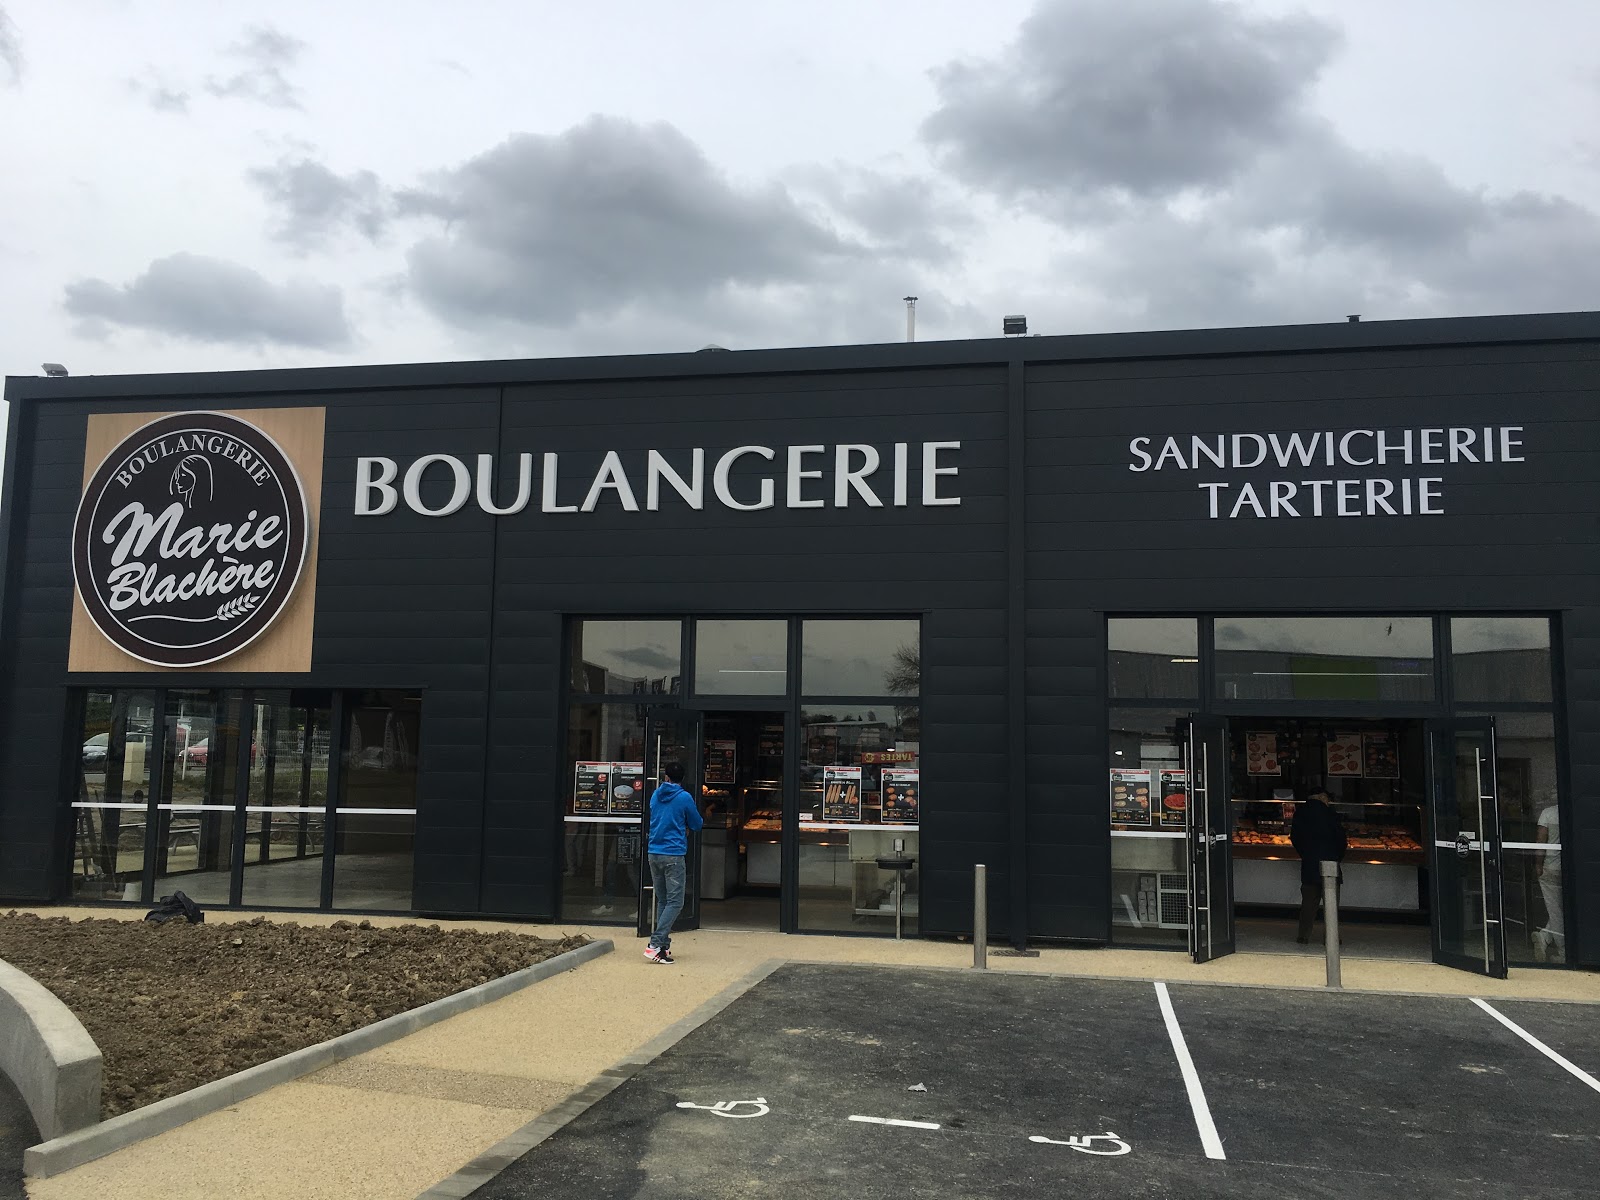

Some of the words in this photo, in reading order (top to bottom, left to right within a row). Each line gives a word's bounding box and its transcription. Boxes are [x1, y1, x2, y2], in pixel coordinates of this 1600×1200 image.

[115, 434, 271, 489] BOULANGERIE
[1128, 426, 1526, 472] SANDWICHERIE
[354, 440, 961, 517] BOULANGERIE
[1198, 477, 1444, 518] TARTERIE
[102, 501, 284, 567] Marie
[107, 556, 275, 611] Blachère
[880, 753, 913, 761] TARTES
